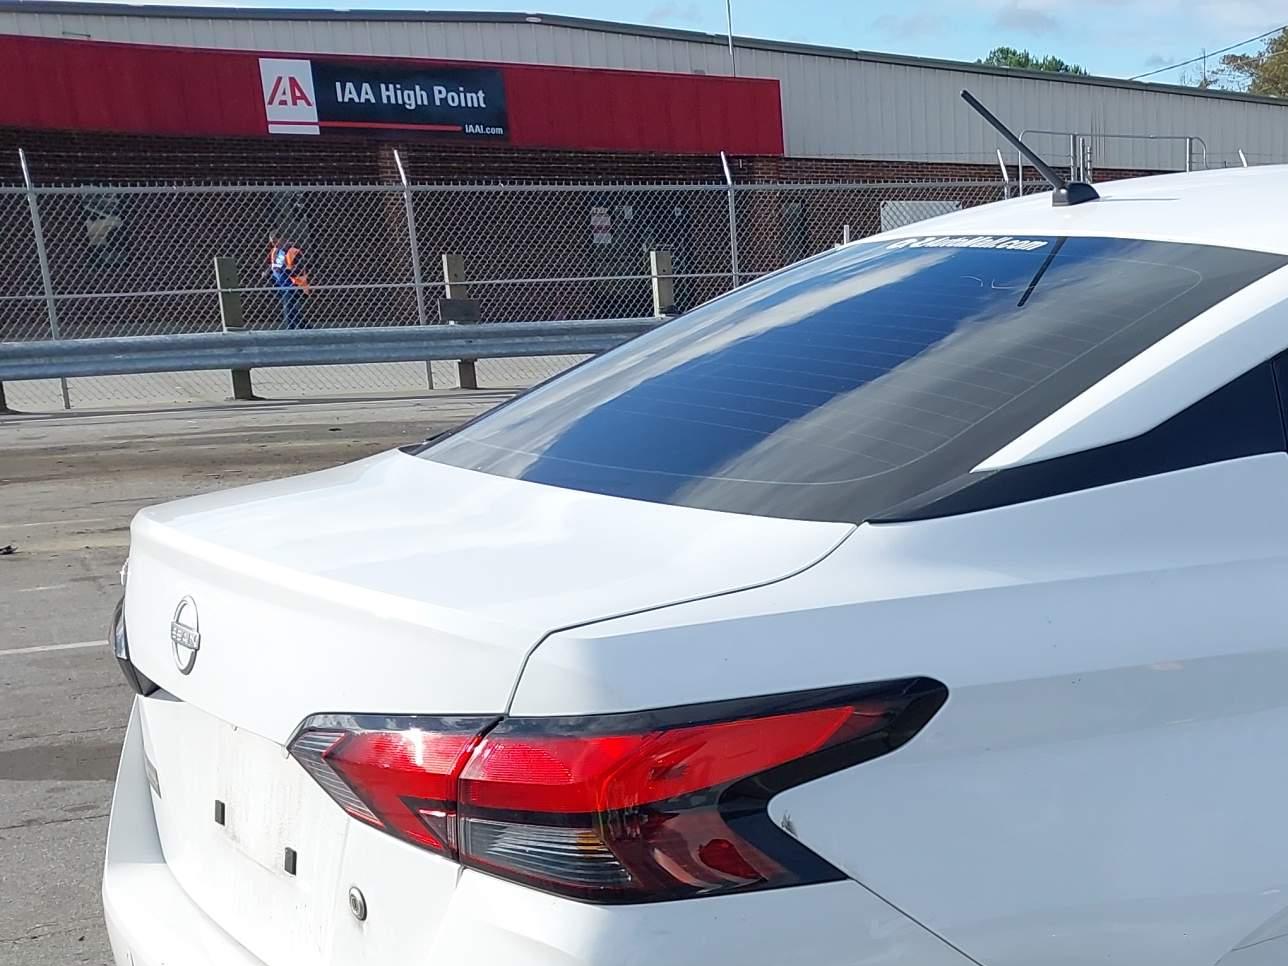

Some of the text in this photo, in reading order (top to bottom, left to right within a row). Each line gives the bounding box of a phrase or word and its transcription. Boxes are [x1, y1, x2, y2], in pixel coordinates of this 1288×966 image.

[335, 81, 486, 110] IAA High Point
